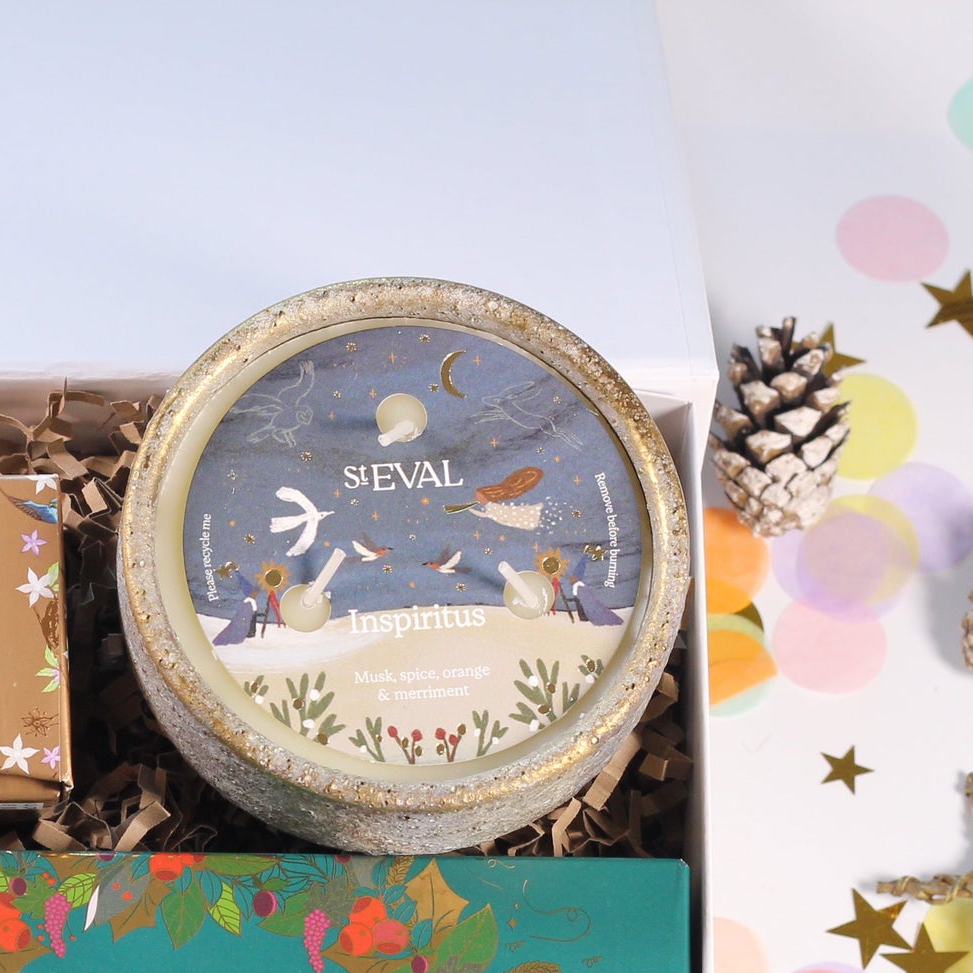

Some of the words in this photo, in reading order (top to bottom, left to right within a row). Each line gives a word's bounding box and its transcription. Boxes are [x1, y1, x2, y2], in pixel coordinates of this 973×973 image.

[594, 472, 614, 514] Remove
[202, 513, 212, 530] me
[607, 514, 619, 547] before
[199, 532, 213, 568] recycle
[604, 548, 620, 588] burning
[205, 569, 219, 602] Please
[348, 604, 486, 638] Inspiritus
[354, 670, 396, 686] Musk,
[400, 668, 440, 686] spice,
[443, 667, 491, 683] orange
[377, 687, 391, 702] &
[394, 684, 470, 701] merriment
